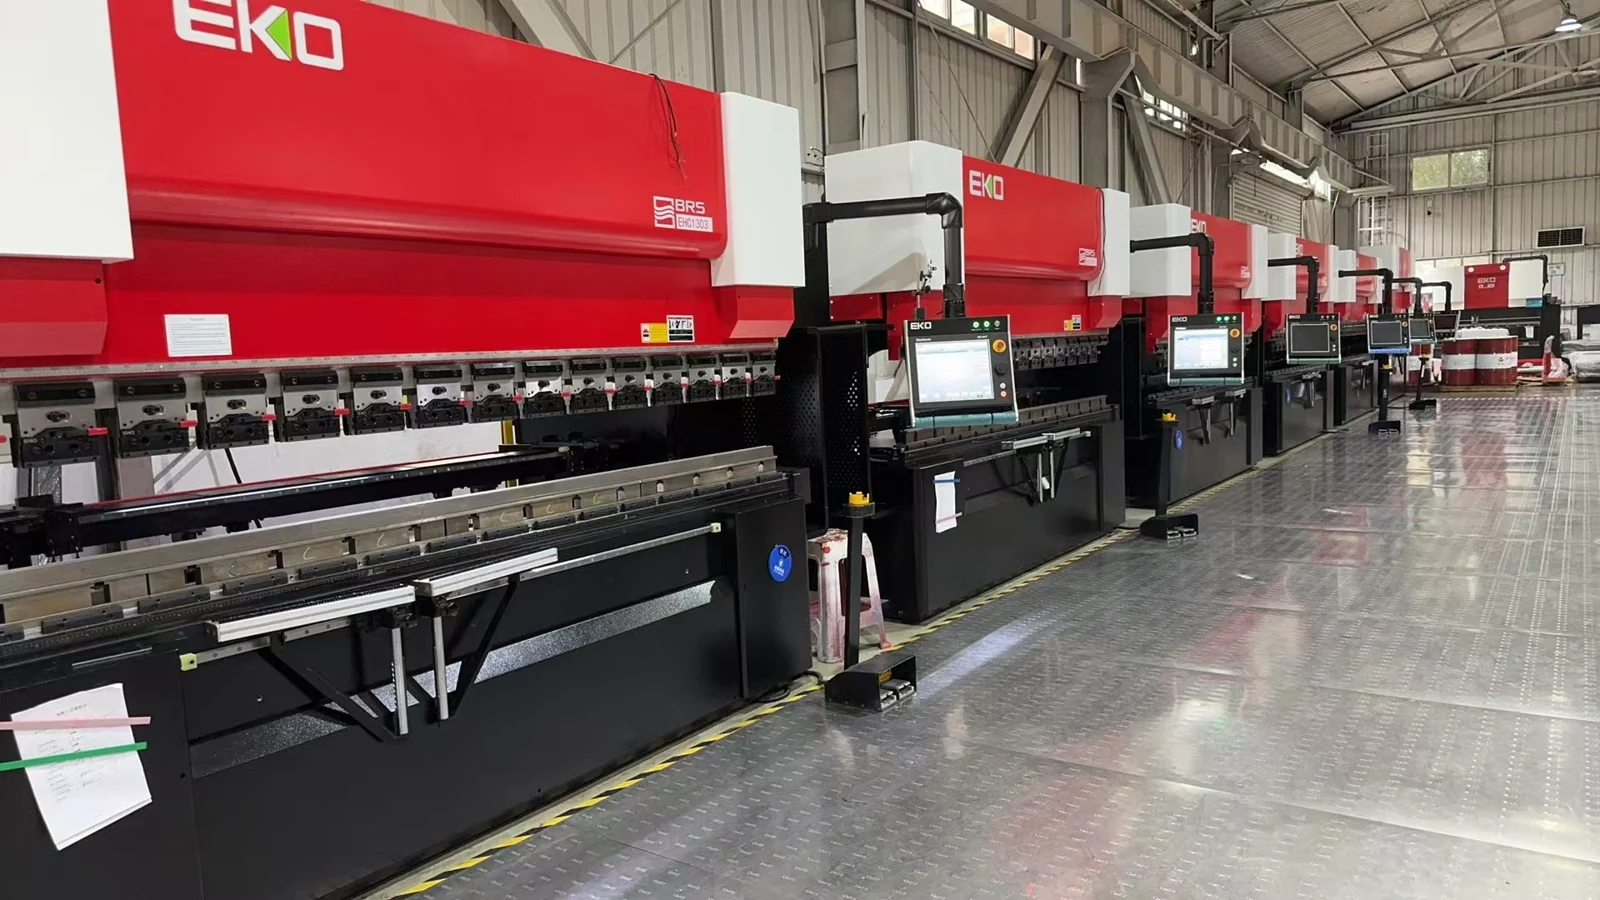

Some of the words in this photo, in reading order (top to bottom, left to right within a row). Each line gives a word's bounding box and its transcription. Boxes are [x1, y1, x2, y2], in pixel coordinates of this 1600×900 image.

[172, 0, 344, 71] EKO
[969, 170, 1004, 200] EKO
[675, 198, 706, 214] BRS
[910, 321, 932, 330] EKO
